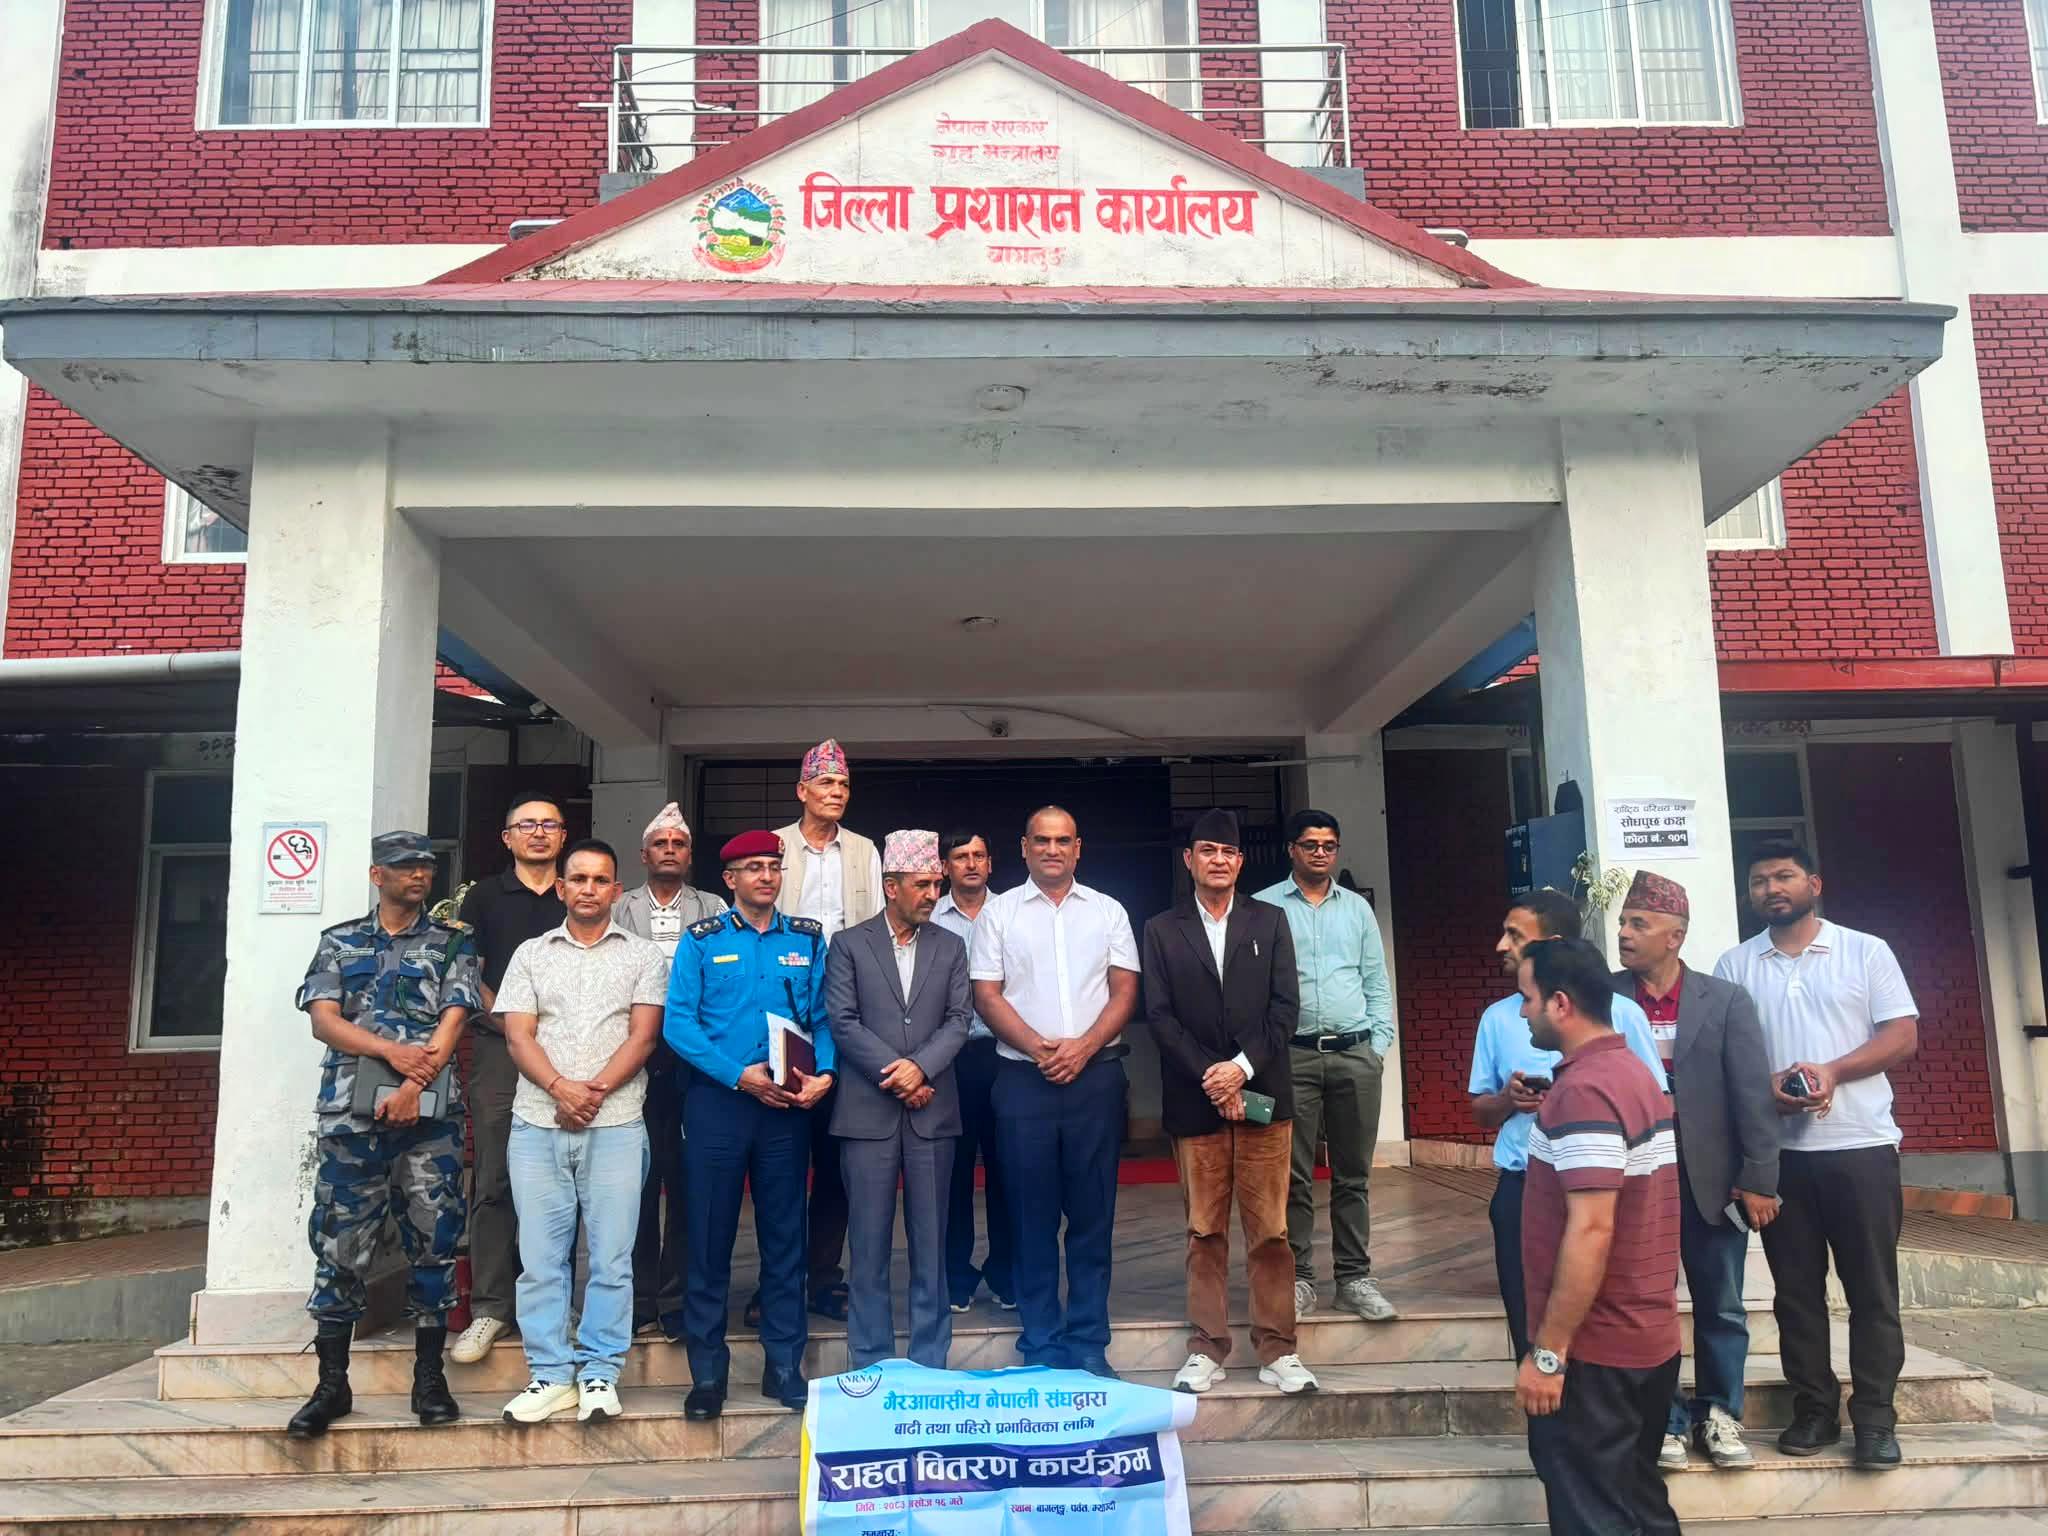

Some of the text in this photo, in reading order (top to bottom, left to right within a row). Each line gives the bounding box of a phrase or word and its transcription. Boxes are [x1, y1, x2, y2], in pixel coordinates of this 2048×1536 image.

[799, 171, 1260, 240] जिल्ला प्रशासन कार्यालय
[1664, 816, 1686, 826] कक्ष
[1624, 833, 1648, 844] कोठा
[1667, 833, 1687, 842] १०१
[845, 1374, 873, 1384] NRNA
[883, 1388, 1108, 1411] गैरआवासीय नेपाली संघद्वारा
[894, 1416, 1095, 1435] बाढी तथा पहिरो प्रभावितका लागि
[831, 1447, 1152, 1491] राहत वितरण कार्यक्रम
